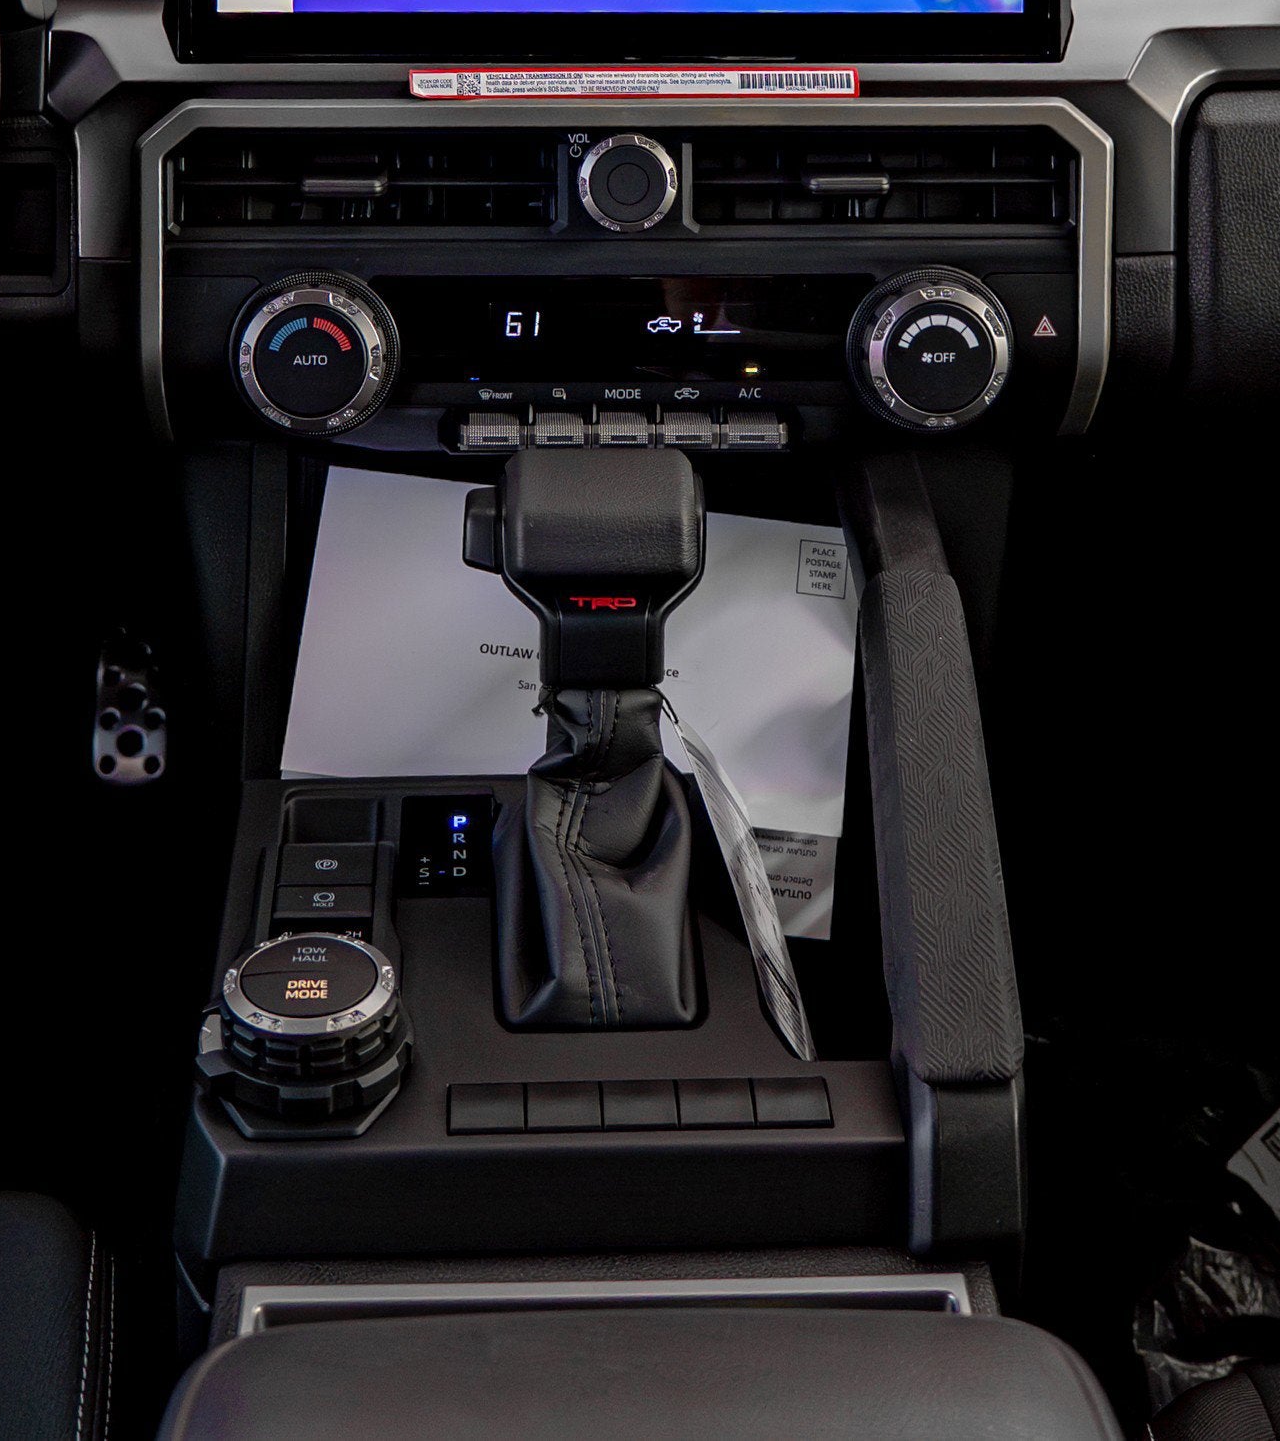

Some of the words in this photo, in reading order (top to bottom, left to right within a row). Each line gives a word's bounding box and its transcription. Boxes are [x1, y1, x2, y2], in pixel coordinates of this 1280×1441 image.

[568, 133, 591, 144] VOL
[505, 311, 540, 337] 61
[293, 354, 328, 366] AUTO
[933, 352, 956, 363] OFF
[492, 391, 513, 400] FRONT
[604, 387, 642, 399] MODE
[738, 387, 762, 399] A/C
[812, 547, 836, 557] PLACE
[805, 557, 841, 569] POSTAGE
[809, 569, 837, 579] STAMP
[811, 582, 832, 591] HERE
[569, 596, 637, 610] TRD
[479, 643, 533, 659] OUTLAW
[518, 679, 537, 691] San
[453, 815, 467, 827] P
[453, 832, 466, 843] R
[453, 849, 466, 860] N
[786, 847, 817, 858] OUTLAW
[419, 867, 429, 878] S
[453, 866, 466, 877] D
[783, 874, 813, 887] Detach
[771, 887, 812, 900] OUTLAW
[287, 979, 328, 989] DRIVE
[285, 989, 328, 999] MODE
